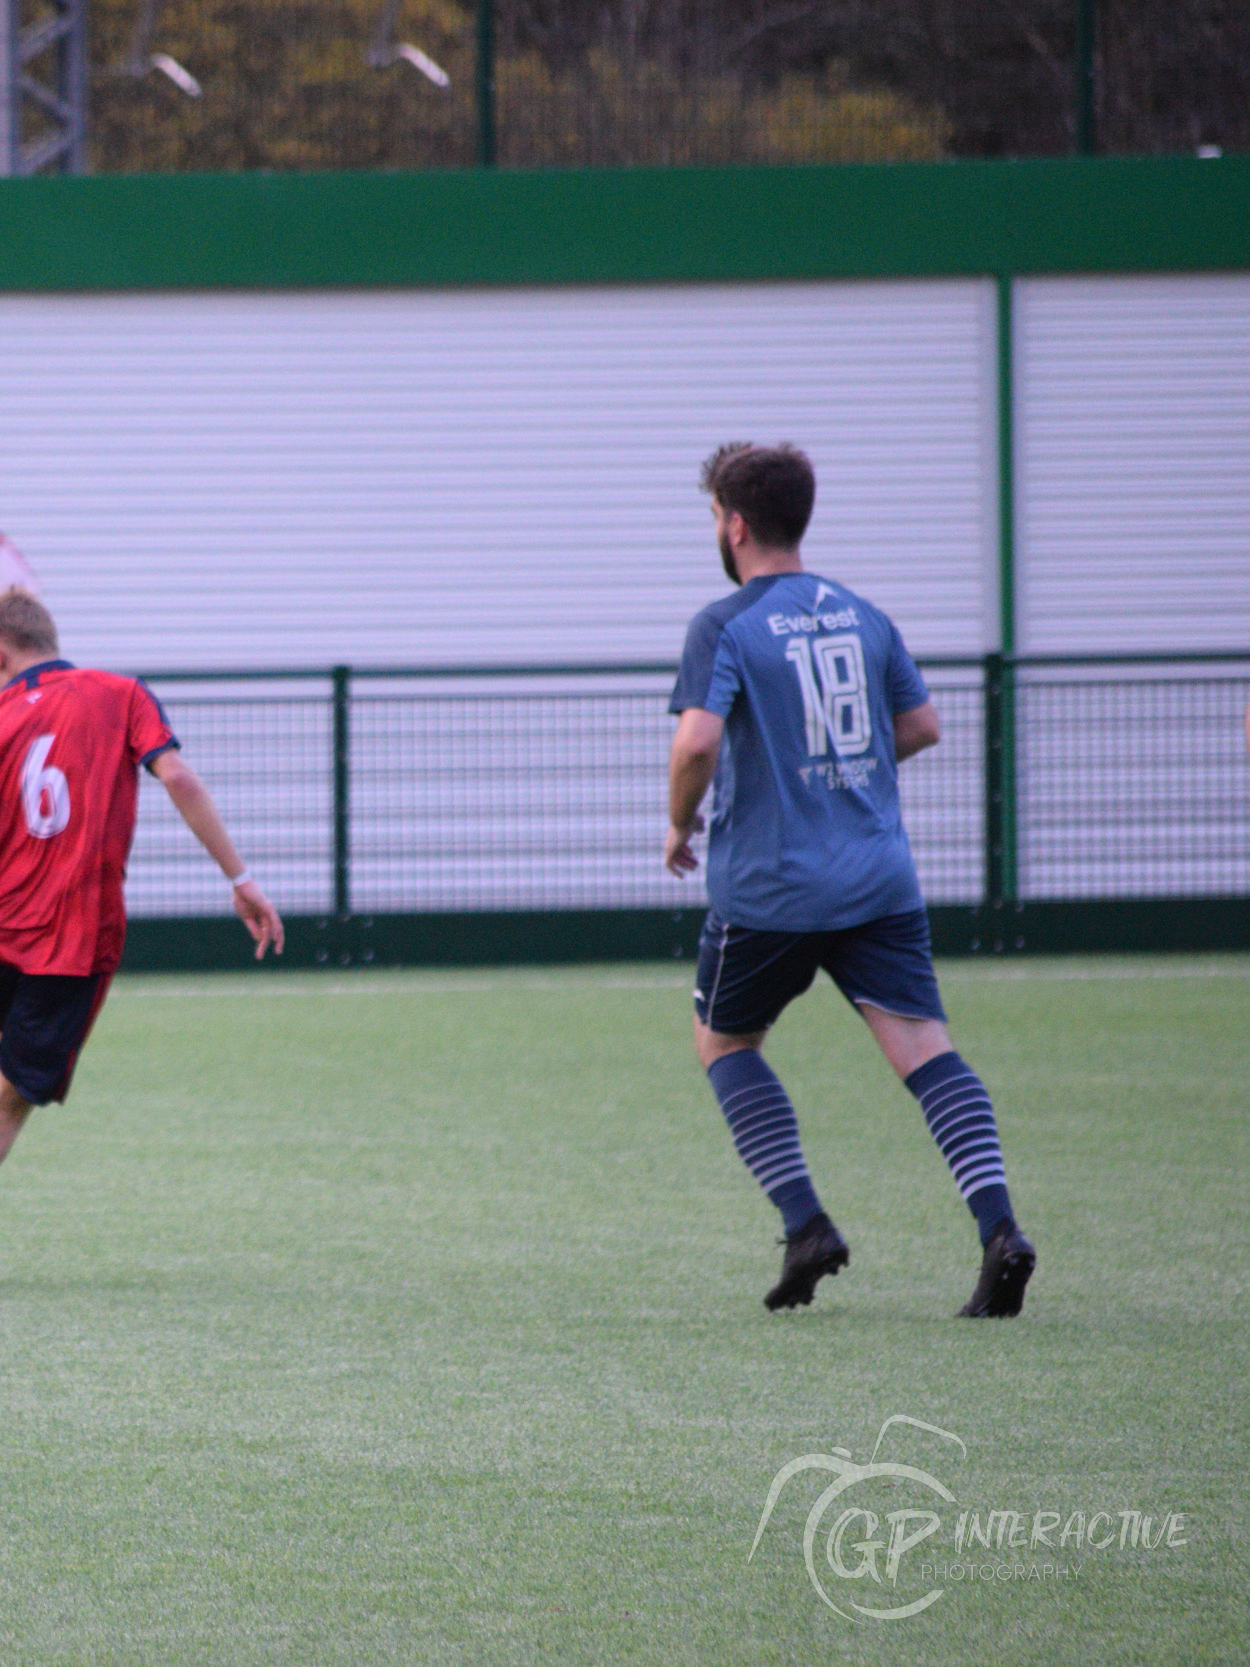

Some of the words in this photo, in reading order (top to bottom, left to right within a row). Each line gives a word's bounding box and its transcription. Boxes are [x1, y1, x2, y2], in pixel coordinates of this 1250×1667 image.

[767, 607, 859, 636] Everest
[785, 633, 872, 757] 18
[21, 733, 71, 839] 6
